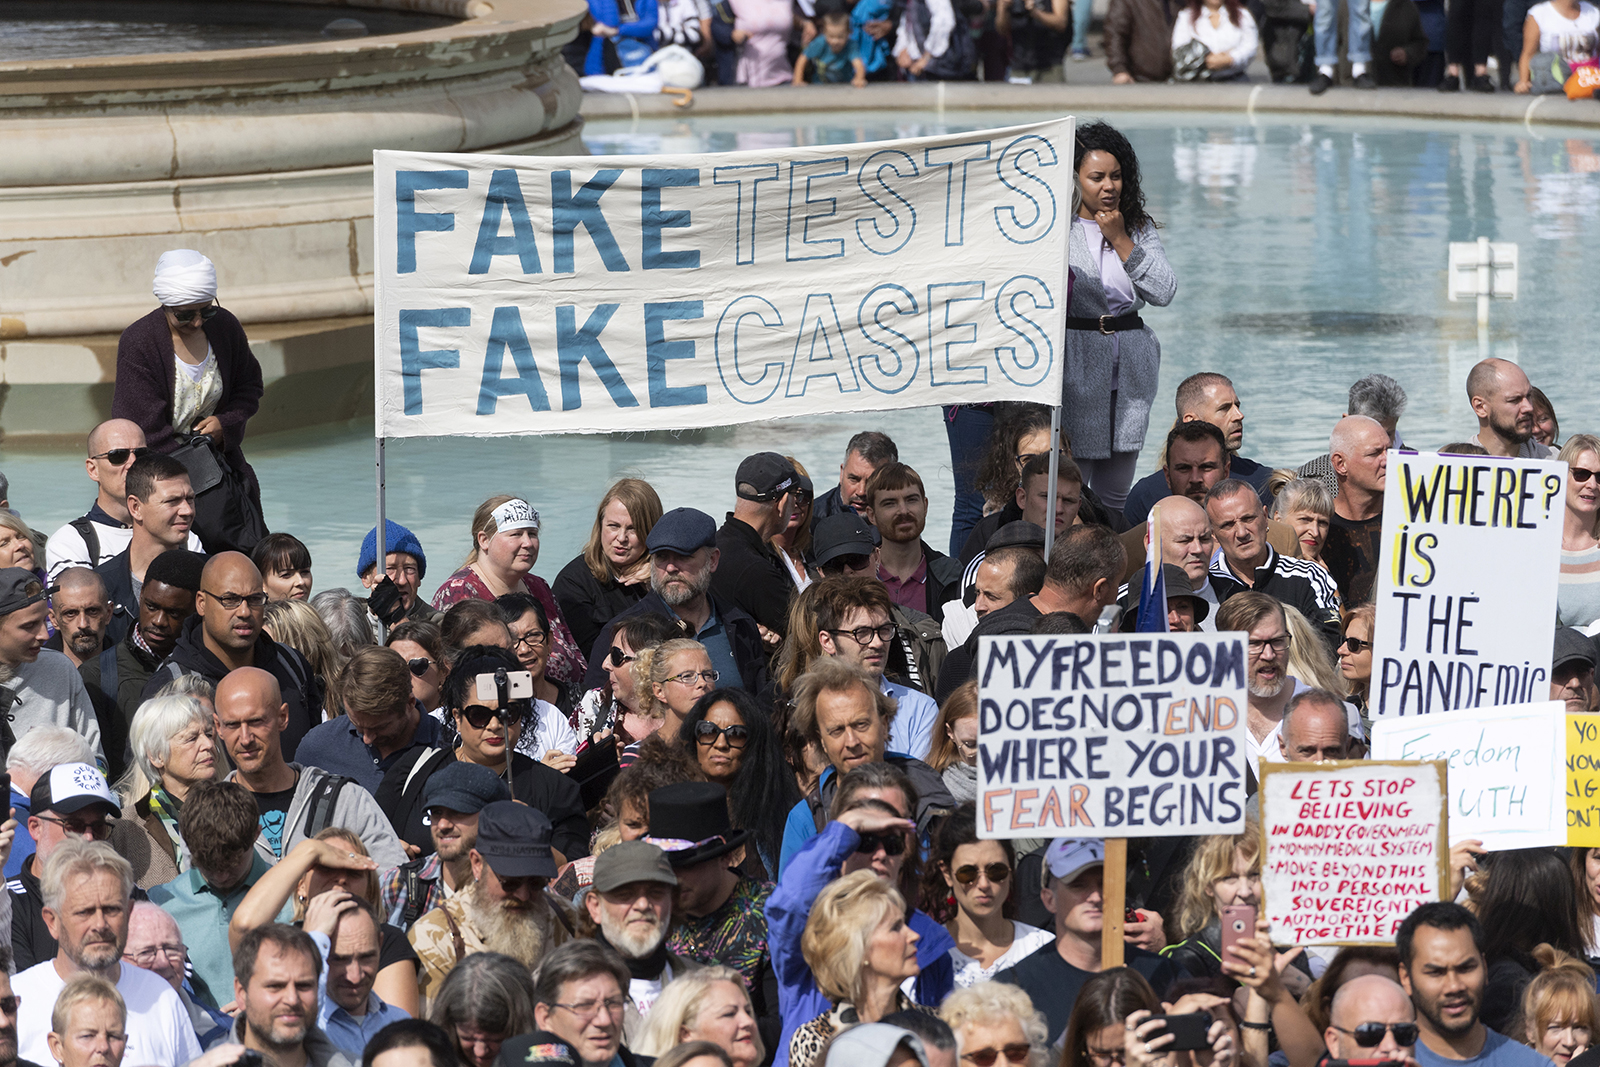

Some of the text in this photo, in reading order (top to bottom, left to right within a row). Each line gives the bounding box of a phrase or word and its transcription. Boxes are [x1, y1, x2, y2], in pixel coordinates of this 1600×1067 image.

[396, 134, 1058, 275] FAKE TESTS
[400, 275, 1054, 416] FAKE CASES
[1398, 463, 1562, 528] WHERE?
[1393, 592, 1479, 655] THE
[982, 639, 1245, 691] MY FREEDOM
[980, 692, 1239, 736] DOES NOT END
[979, 737, 1242, 785] WHERE YOUR
[984, 781, 1242, 832] FEAR BEGINS
[1290, 777, 1415, 800] LETS STOP
[1458, 785, 1528, 818] UTH
[1298, 801, 1412, 820] BELIEVING
[1271, 823, 1435, 840] IN DADDY GOVERNMENT
[1325, 842, 1376, 857] MEDICAL
[1380, 841, 1433, 857] SYSTEM
[1291, 880, 1432, 896] INTO PERSONAL
[1322, 862, 1387, 879] BEYOND
[1391, 864, 1426, 879] THIS
[1283, 914, 1387, 928] AUTHORITY
